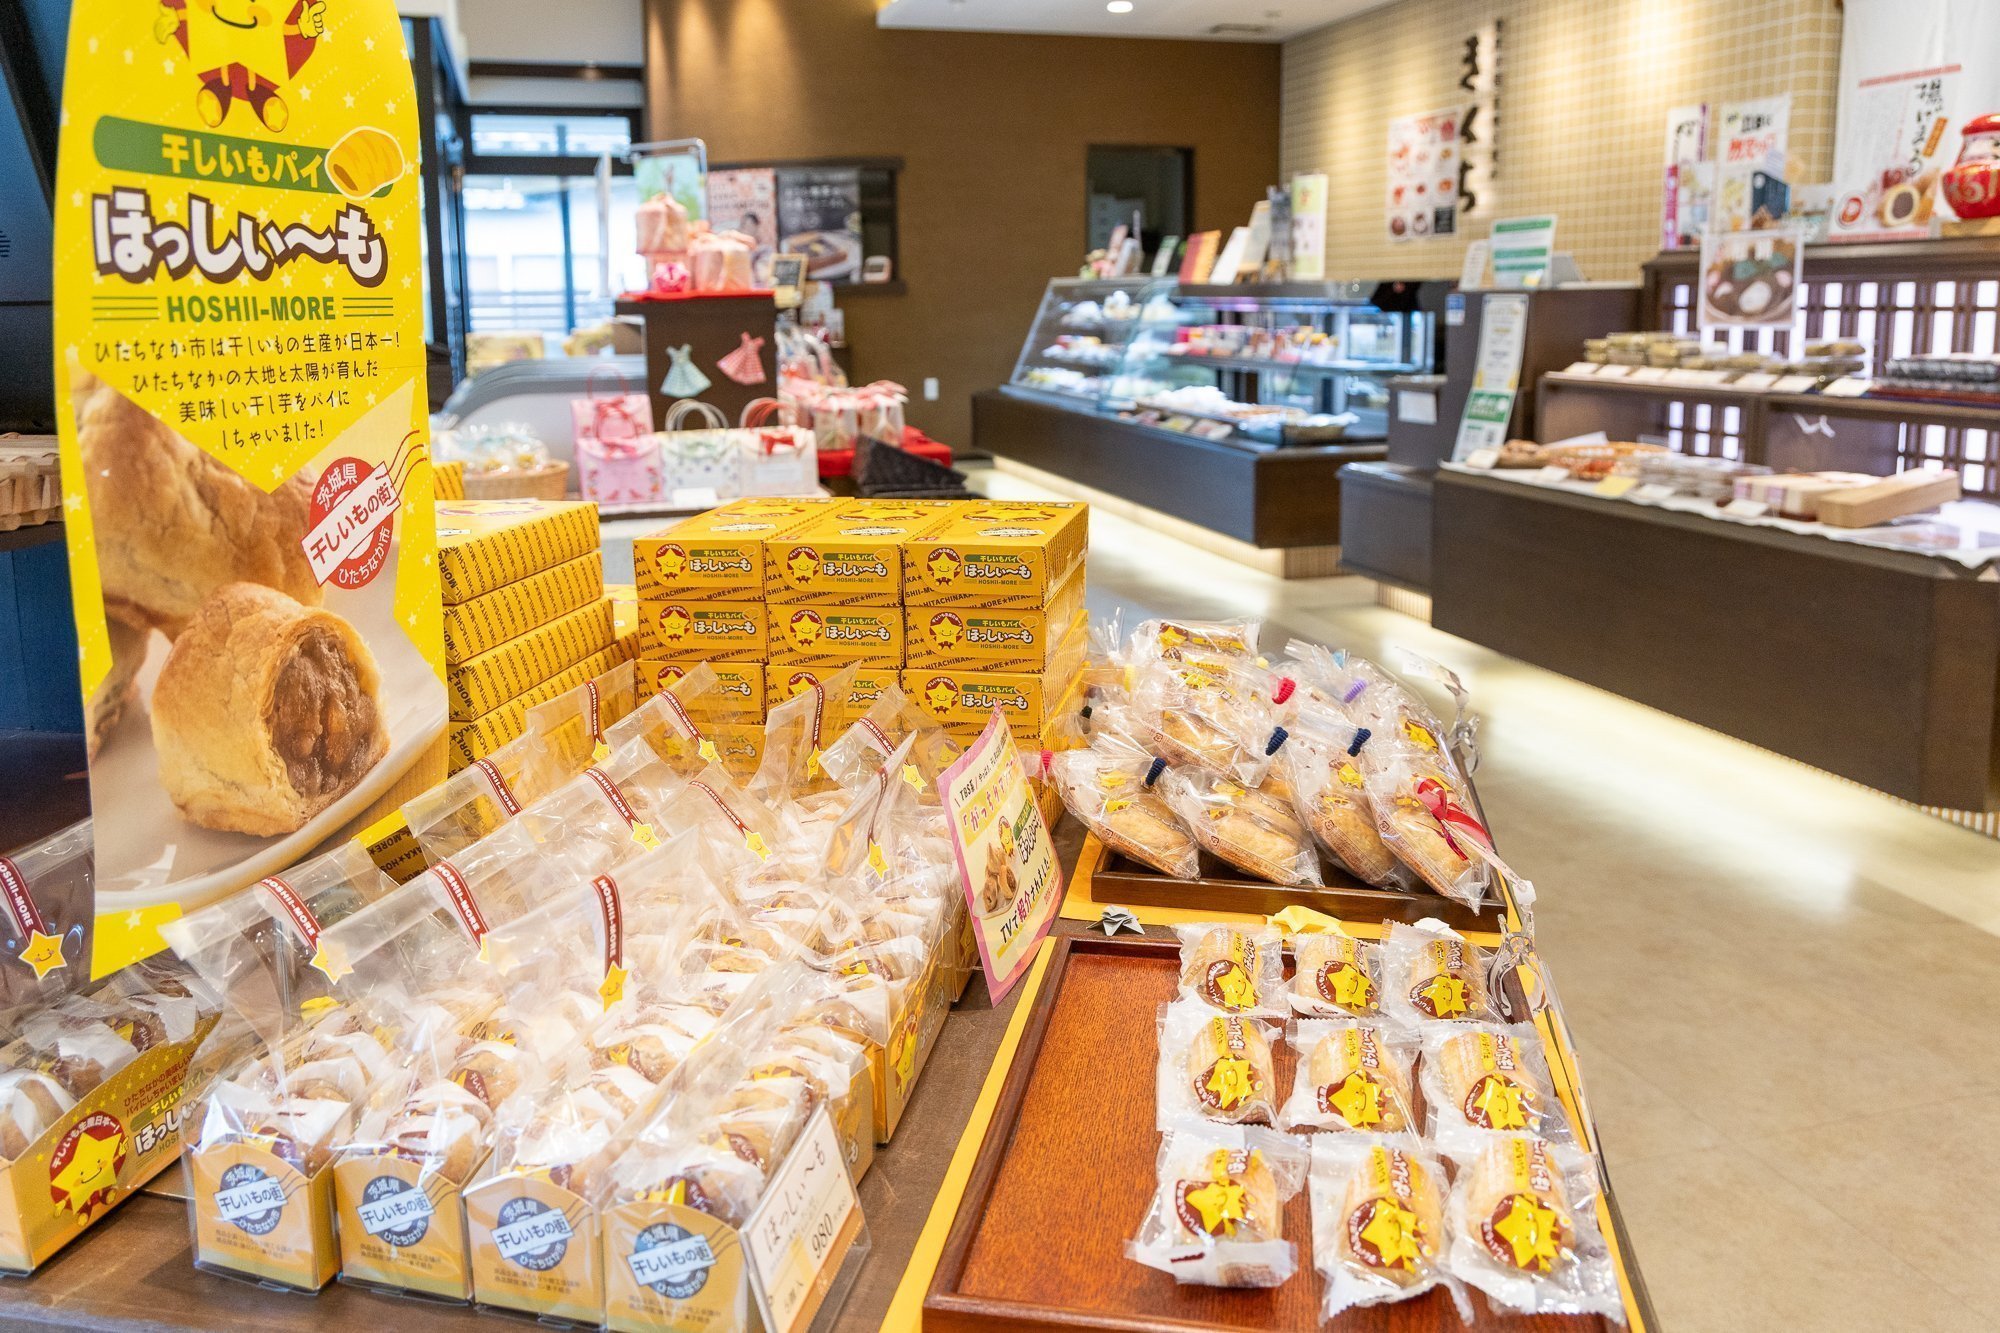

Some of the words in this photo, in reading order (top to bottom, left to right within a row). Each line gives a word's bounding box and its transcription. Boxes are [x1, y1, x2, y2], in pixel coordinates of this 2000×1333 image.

[162, 133, 324, 188] 干しいもパイ
[167, 296, 336, 323] HOSHII-MORE
[132, 358, 379, 393] ひたちなかの大地と太陽が育んだ
[179, 390, 351, 424] 美味しい干し芋をパイに
[221, 419, 325, 449] しちゃいました!
[316, 462, 358, 511] 茨城県
[310, 481, 394, 565] 干しいもの街
[338, 526, 391, 585] ひたちなか市
[663, 690, 698, 737] HOSHII-MORE
[478, 759, 517, 813] HOSHII-MORE
[586, 768, 631, 819] HOSHII-MORE
[263, 878, 317, 937] HOSHII-MORE
[435, 864, 482, 932] HOSHII-MORE
[597, 878, 617, 959] HOSHII-MORE
[219, 1186, 285, 1213] 干しいもの街
[362, 1194, 429, 1226] 干しいもの街
[497, 1218, 570, 1250] 干しいもの街
[811, 1212, 834, 1260] 980
[634, 1243, 711, 1277] 干しいもの街
